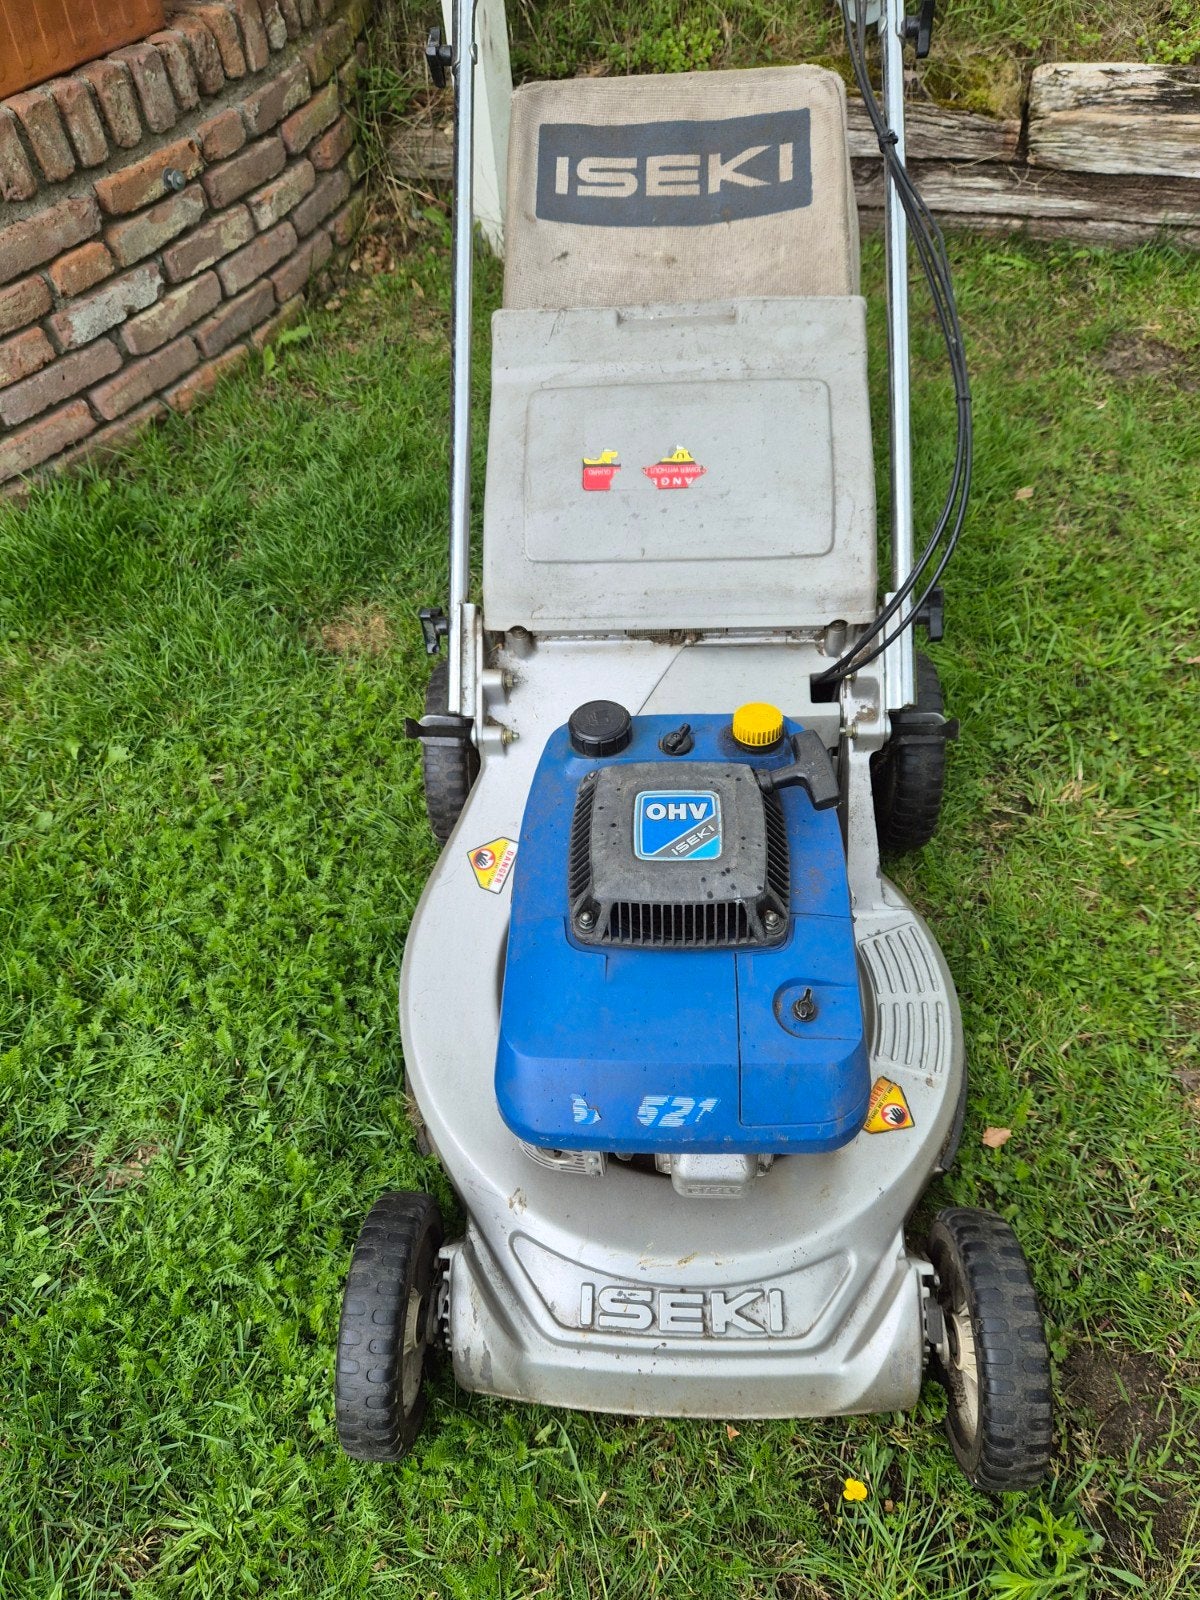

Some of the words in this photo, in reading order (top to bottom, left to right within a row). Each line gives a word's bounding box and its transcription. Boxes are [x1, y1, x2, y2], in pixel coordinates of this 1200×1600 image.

[555, 142, 793, 198] ISEKI
[645, 803, 708, 820] OHV
[671, 825, 715, 855] ISEKI
[494, 850, 515, 884] DANGER
[580, 1282, 784, 1333] ISEKI
